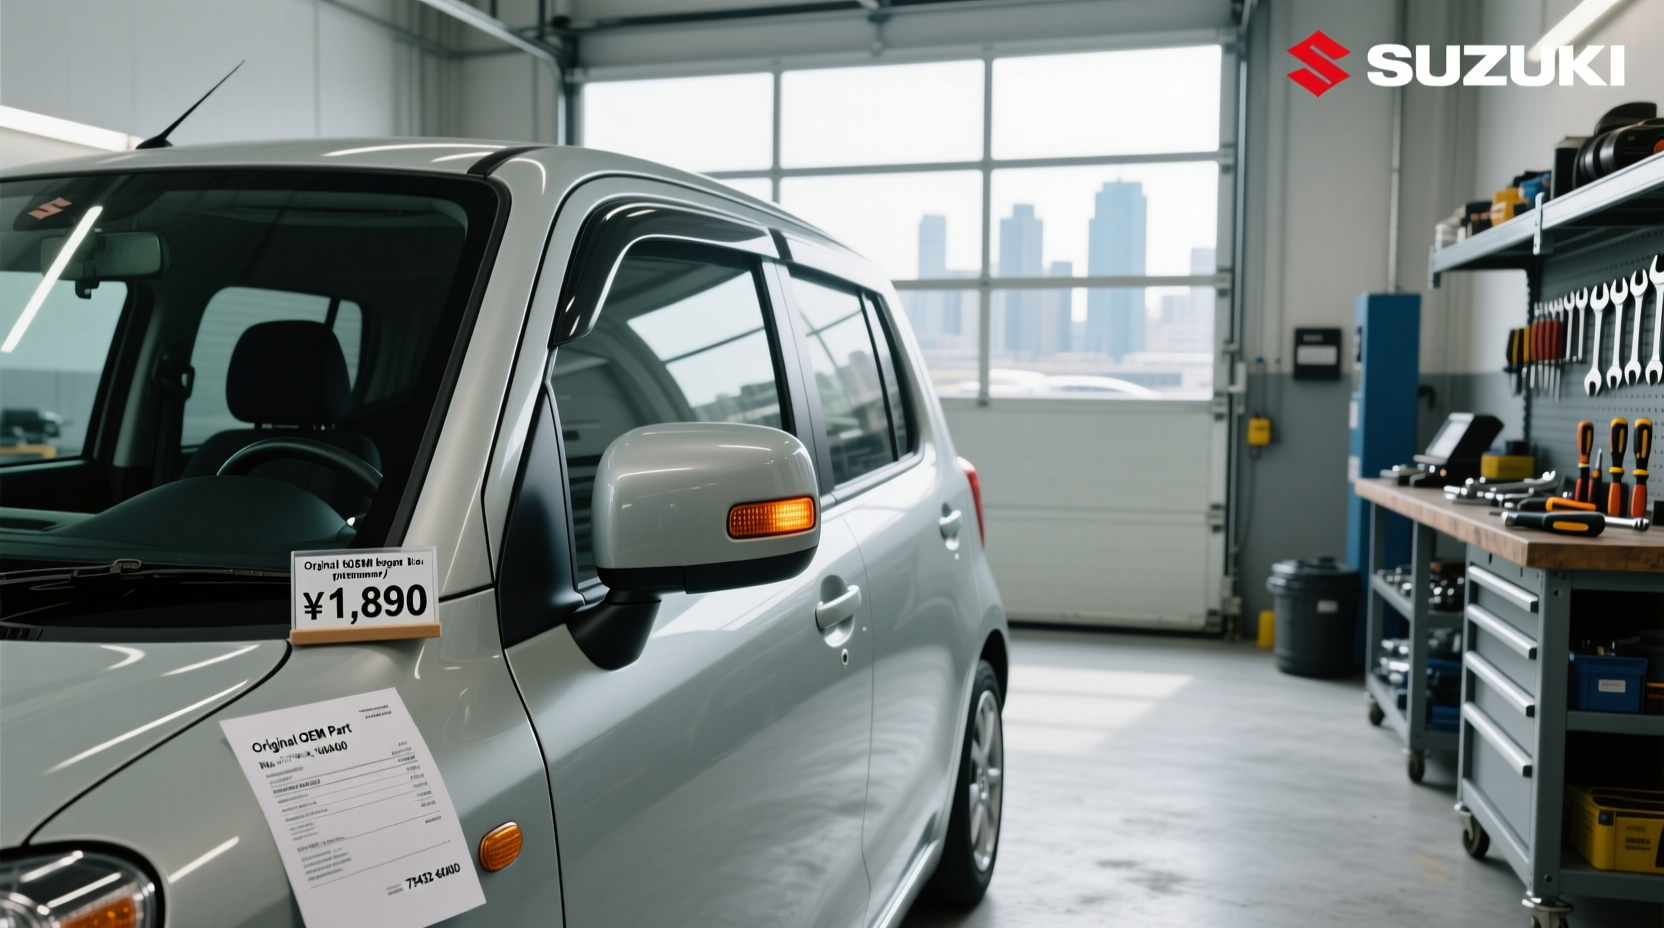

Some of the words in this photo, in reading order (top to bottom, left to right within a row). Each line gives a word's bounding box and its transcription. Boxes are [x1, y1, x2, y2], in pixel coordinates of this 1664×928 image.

[302, 584, 428, 625] ¥1,890
[252, 734, 298, 753] Original
[327, 723, 352, 738] Part
